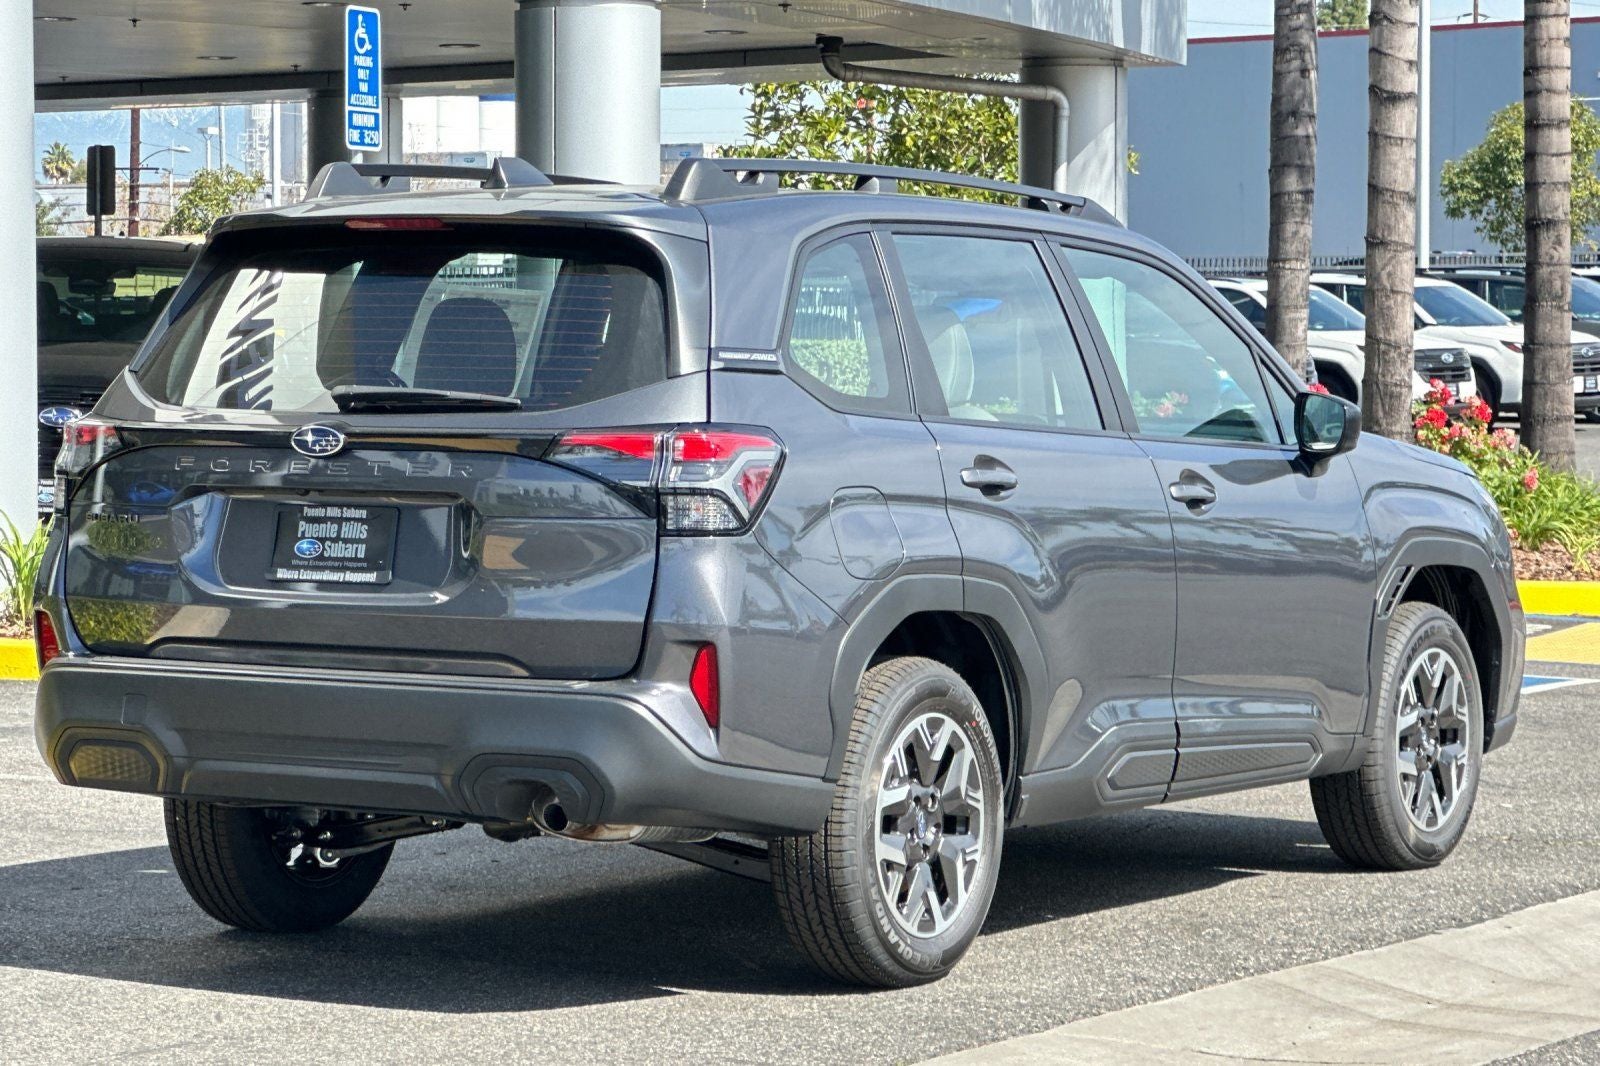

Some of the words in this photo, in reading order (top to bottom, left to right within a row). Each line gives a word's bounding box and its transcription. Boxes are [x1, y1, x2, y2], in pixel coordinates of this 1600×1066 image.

[353, 55, 374, 68] PARKING
[357, 68, 370, 81] ONLY
[358, 81, 369, 93] VAN
[350, 93, 377, 107] ACCESSIBLE
[352, 112, 375, 128] MINIMUM
[348, 128, 361, 143] FINE
[362, 129, 379, 145] $250
[174, 455, 473, 479] FORESTER
[85, 511, 141, 523] SUBARU
[303, 506, 326, 518] Puente
[326, 507, 342, 518] Hills
[342, 507, 367, 519] Subaru
[298, 520, 339, 539] Puente
[340, 521, 369, 540] Hills
[323, 540, 367, 559] Subaru
[291, 559, 308, 567] Where
[309, 560, 343, 569] Extraordinary
[276, 568, 299, 580] Where
[299, 569, 344, 582] Extraordinary
[344, 571, 377, 583] Happens!
